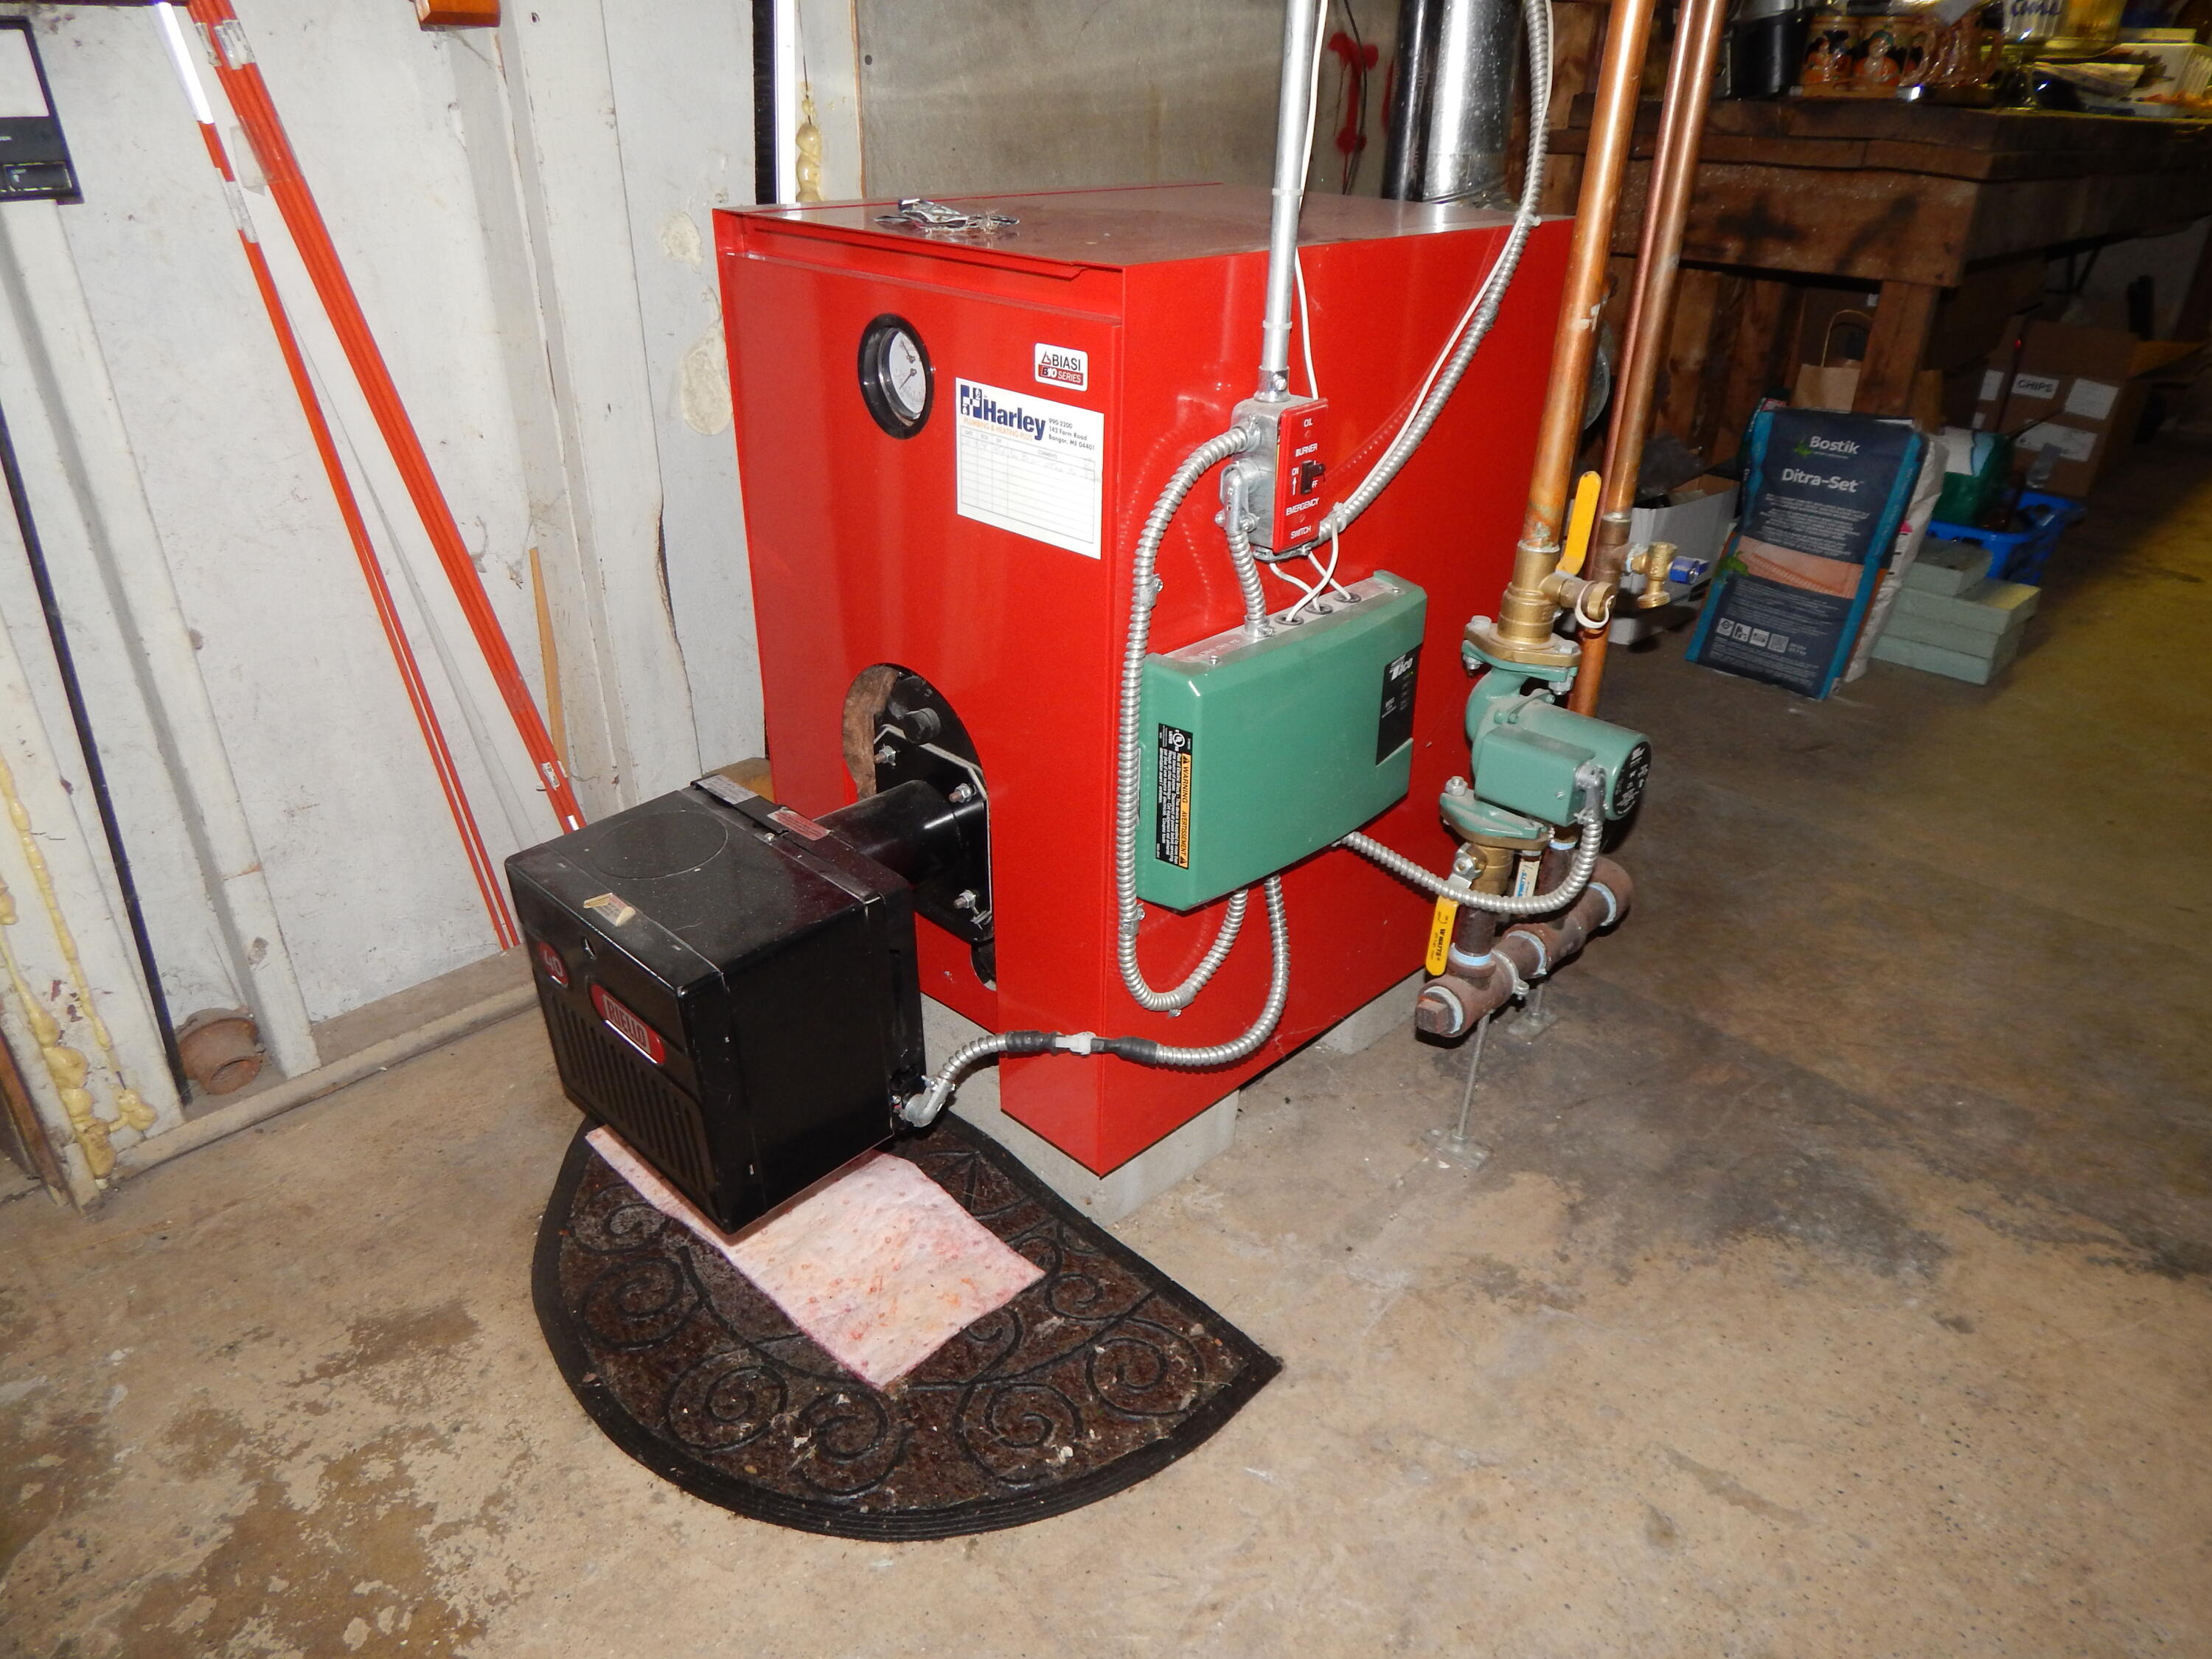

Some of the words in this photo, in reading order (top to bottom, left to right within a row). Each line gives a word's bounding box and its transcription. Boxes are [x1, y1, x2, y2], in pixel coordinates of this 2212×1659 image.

[1052, 354, 1081, 372] BIASI
[1041, 366, 1057, 378] B10
[1058, 368, 1082, 383] SERIES
[2017, 379, 2053, 393] CHIPS
[964, 418, 990, 431] PLUMBING
[996, 426, 1019, 438] HEATING
[984, 399, 1046, 441] Harley
[1304, 418, 1313, 427] OIL
[1048, 434, 1068, 445] Bangor,
[1079, 442, 1095, 451] 04401
[1060, 428, 1073, 437] Farm
[1074, 432, 1088, 441] Road
[1295, 443, 1318, 457] BURNER
[1809, 436, 1861, 455] Bostik
[1292, 467, 1299, 476] ON
[1781, 468, 1858, 493] Ditra-Set
[1285, 497, 1320, 516] EMERGENCY
[1290, 525, 1311, 540] SWITCH
[1436, 936, 1444, 957] WATTS
[543, 950, 563, 978] 40
[606, 1000, 647, 1048] RIELLO
